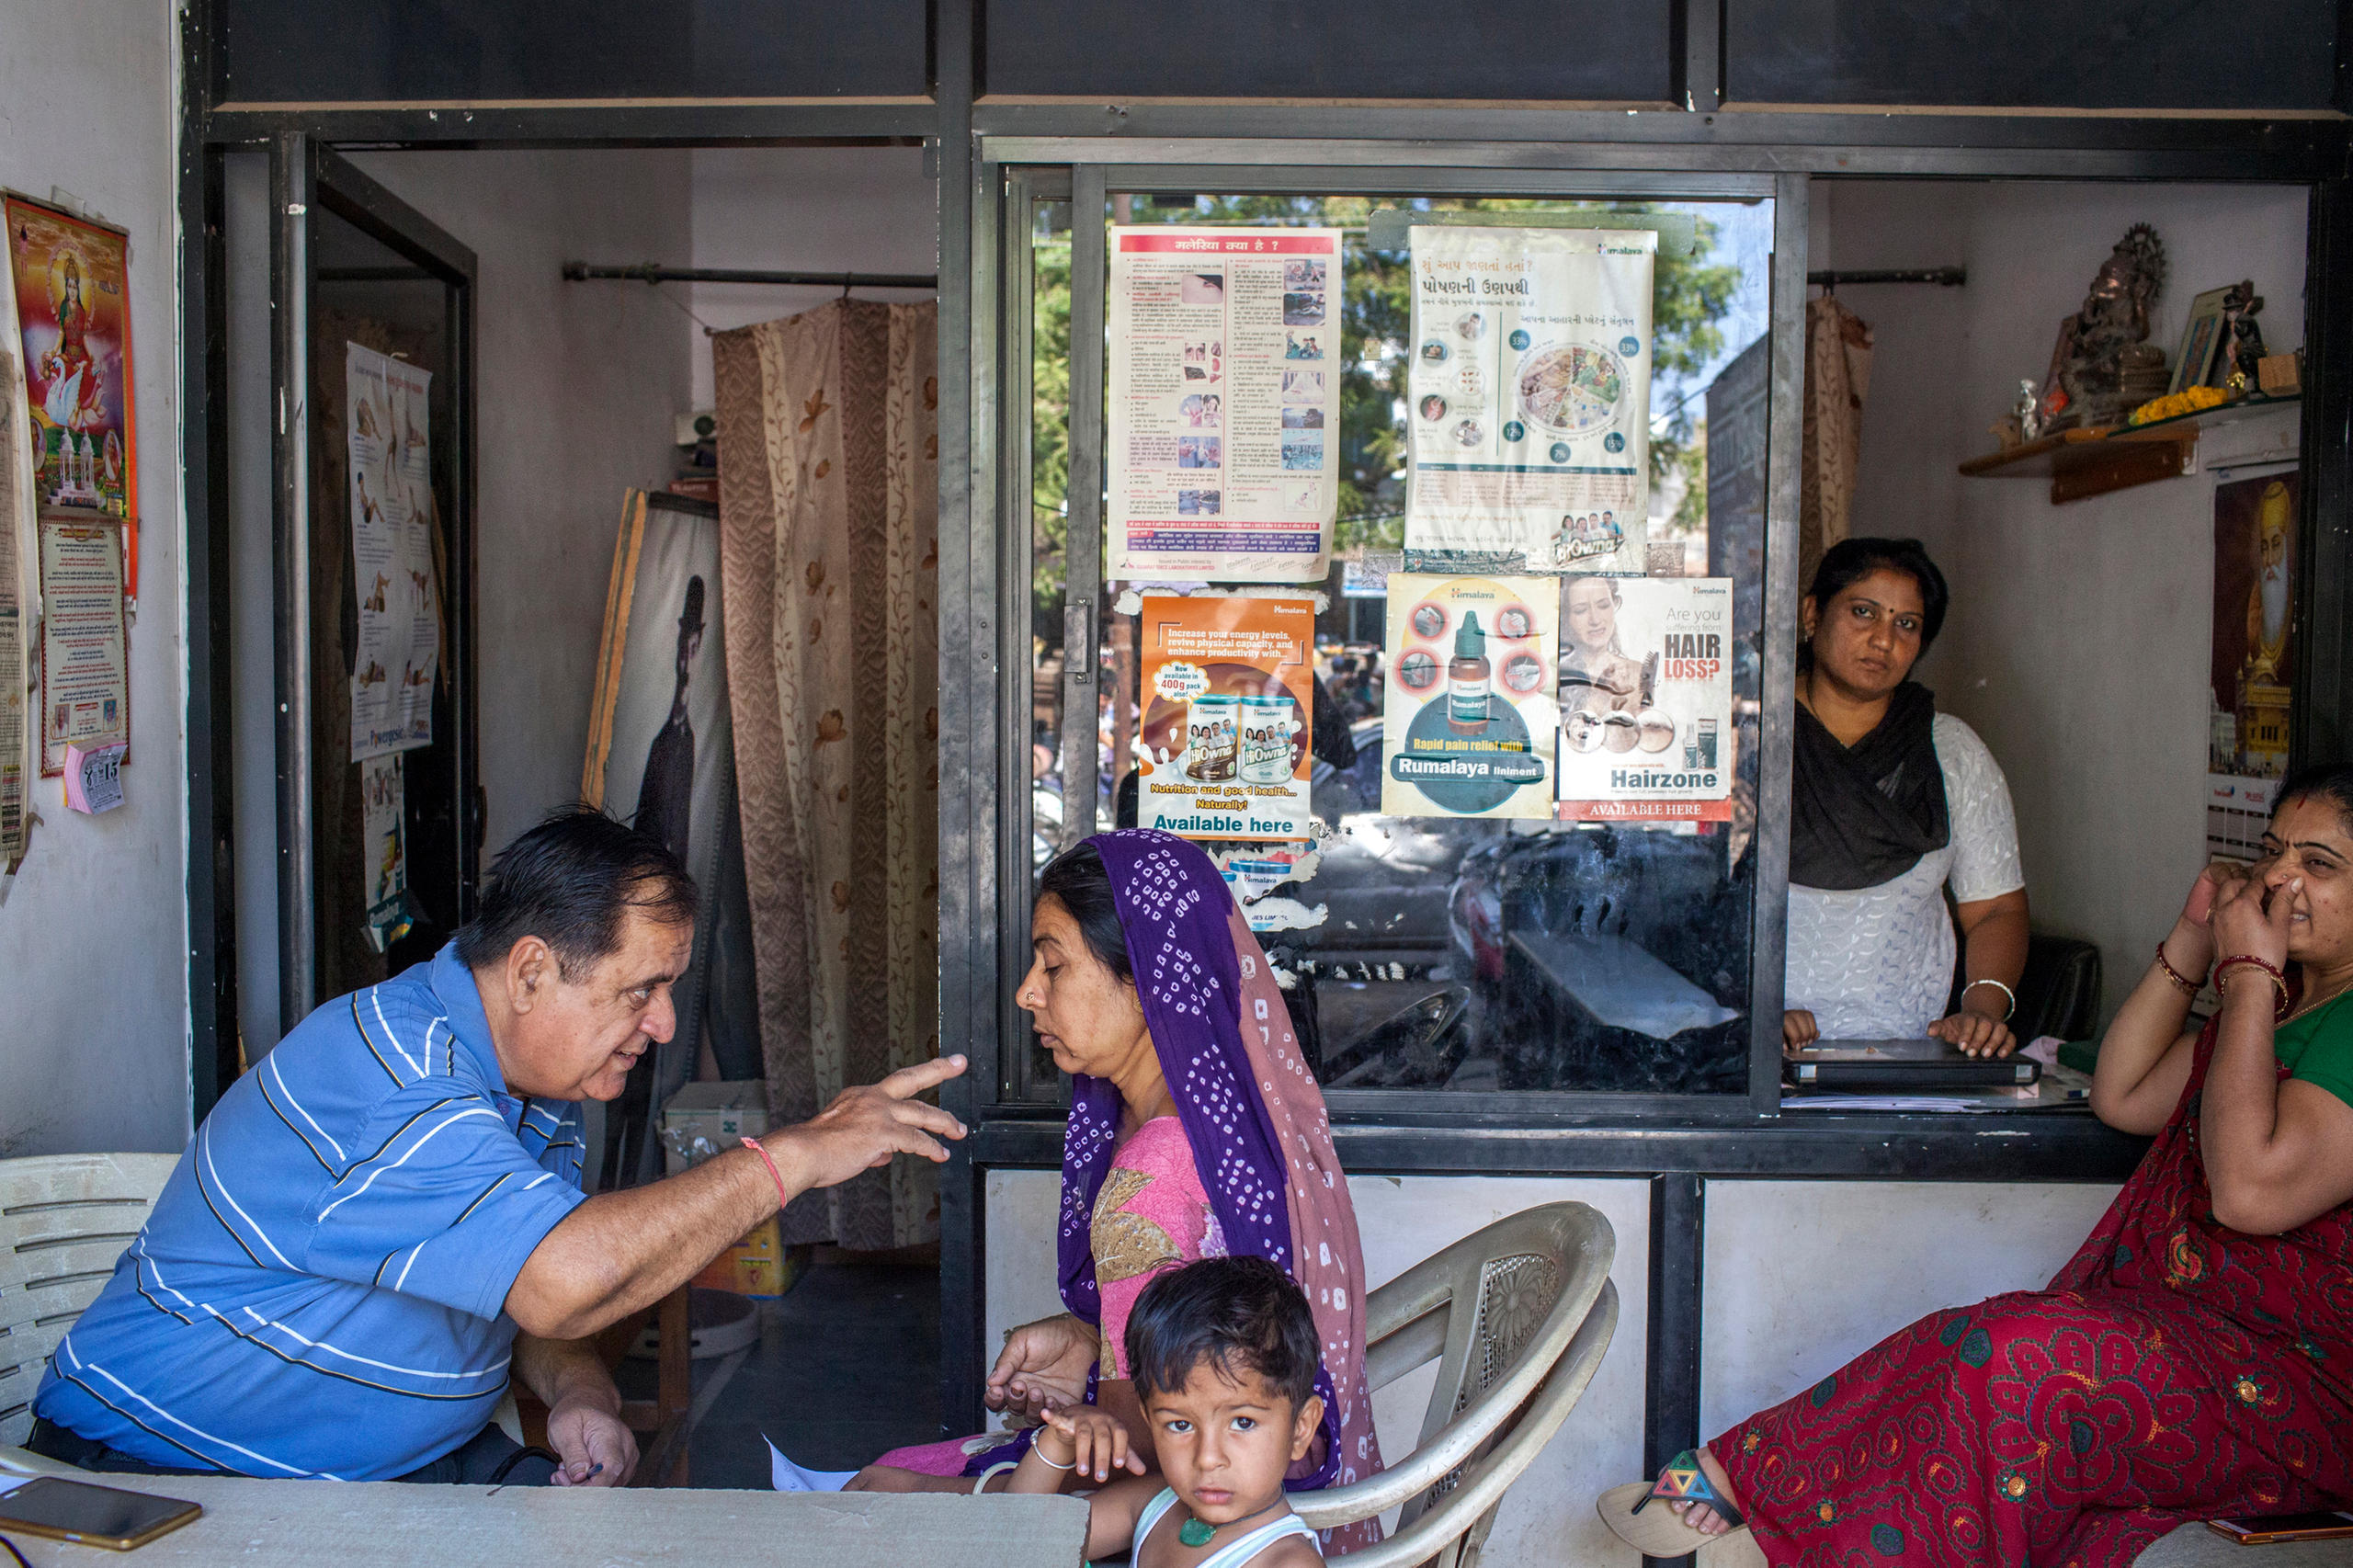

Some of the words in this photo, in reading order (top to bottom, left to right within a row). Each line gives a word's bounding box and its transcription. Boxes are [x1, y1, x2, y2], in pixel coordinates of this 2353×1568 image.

[1175, 240, 1219, 251] मलेरिया
[1225, 241, 1248, 251] क्या
[1255, 240, 1264, 251] है
[1272, 242, 1279, 251] ?
[1423, 276, 1475, 294] પોષણની
[1482, 278, 1529, 294] ઉણપથી
[1512, 336, 1527, 346] 33%
[1451, 587, 1495, 600] Himalaya
[1274, 605, 1307, 614] Himalaya
[1666, 608, 1690, 620] Are
[1694, 610, 1721, 624] you
[1665, 624, 1700, 633] suffering
[1701, 623, 1721, 631] from
[1168, 629, 1207, 638] Increase
[1208, 631, 1228, 640] your
[1229, 631, 1259, 641] energy
[1168, 638, 1195, 646] revive
[1197, 639, 1234, 649] physical
[1276, 640, 1293, 649] and
[1665, 633, 1722, 659] HAIR
[1167, 647, 1206, 656] enhance
[1208, 648, 1259, 659] productivity
[1664, 659, 1721, 679] LOSS?
[1414, 738, 1444, 751] Rapid
[1445, 739, 1469, 751] pain
[1470, 739, 1499, 751] relief
[1500, 740, 1523, 752] with
[1399, 757, 1489, 778] Rumalaya
[1494, 766, 1537, 776] liniment
[1611, 769, 1717, 788] Hairzone
[1151, 784, 1198, 794] Nutrition
[1200, 786, 1222, 795] and
[1224, 786, 1253, 797] good
[1196, 800, 1248, 812] Naturally!
[1590, 804, 1663, 817] AVAILABLE
[1665, 804, 1701, 816] HERE
[1154, 814, 1243, 832] Available
[1250, 817, 1293, 833] here
